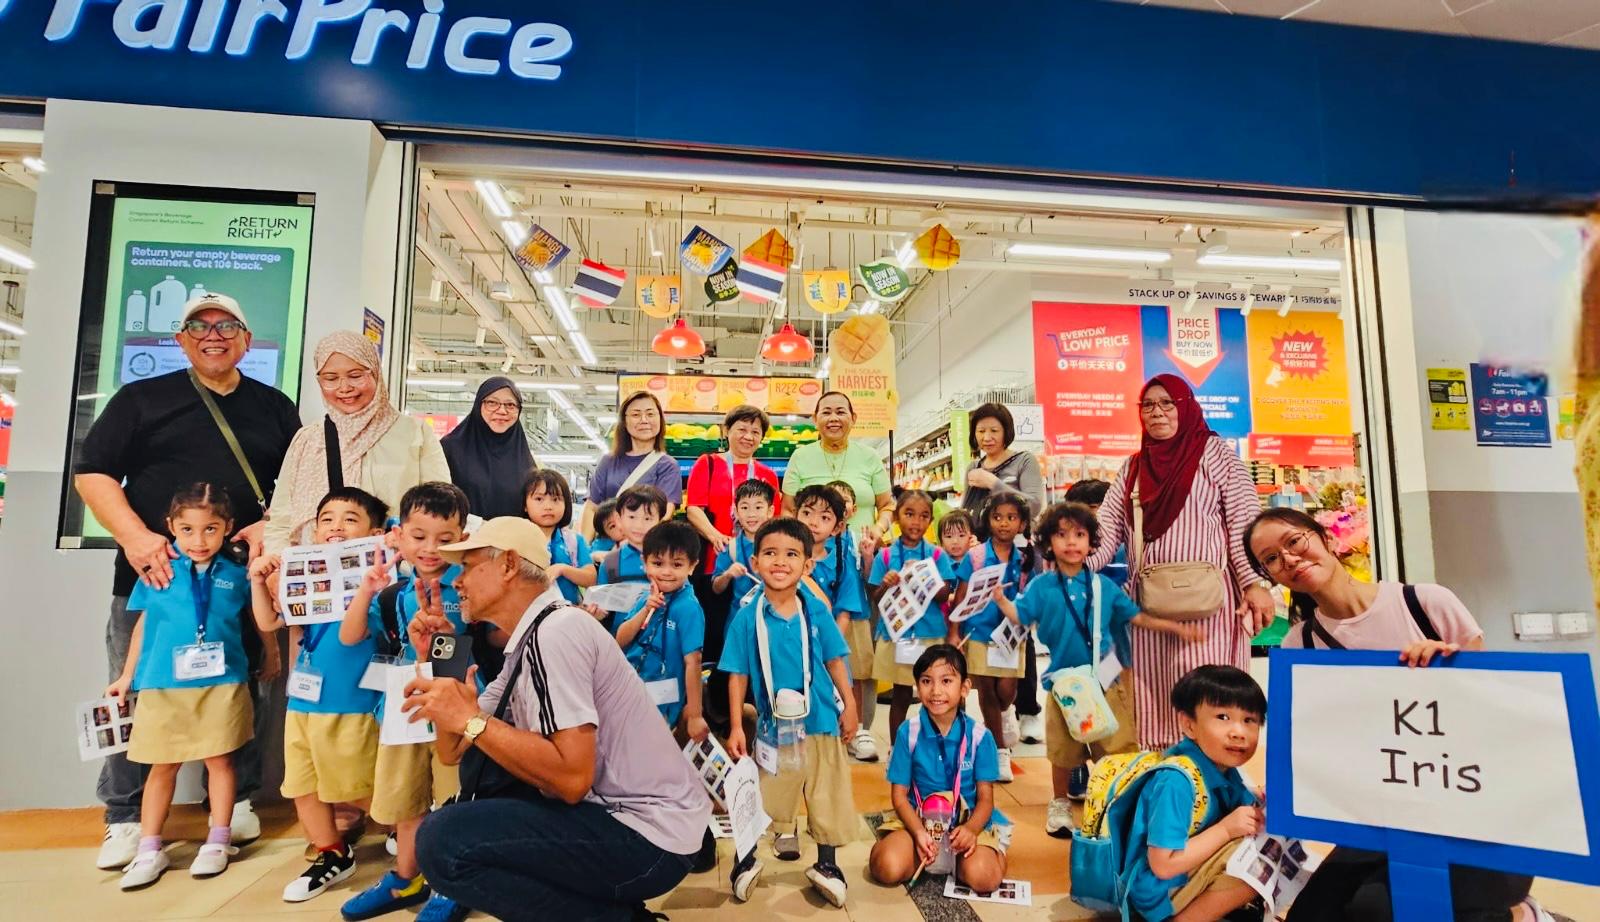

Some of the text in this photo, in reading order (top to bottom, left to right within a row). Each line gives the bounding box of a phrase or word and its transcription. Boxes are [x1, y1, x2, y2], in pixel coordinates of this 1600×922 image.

[239, 217, 298, 229] RETURN
[227, 228, 273, 239] RIGHT
[532, 230, 563, 255] MANGO
[131, 247, 281, 263] Return your empty beverage
[131, 257, 191, 268] containers.
[192, 259, 212, 269] Get
[233, 260, 263, 271] back.
[872, 266, 896, 282] NOW IN
[875, 275, 900, 291] SEASON
[1128, 288, 1159, 298] STACK
[1162, 290, 1175, 299] UP
[1177, 318, 1209, 328] PRICE
[1060, 326, 1106, 340] EVERYDAY
[1178, 329, 1211, 340] DROP
[1063, 334, 1130, 352] LOW PRICE
[1283, 341, 1314, 352] NEW
[837, 375, 888, 390] HARVEST
[1510, 388, 1528, 396] 11pm
[1393, 699, 1445, 736] K1
[1380, 748, 1482, 793] Iris
